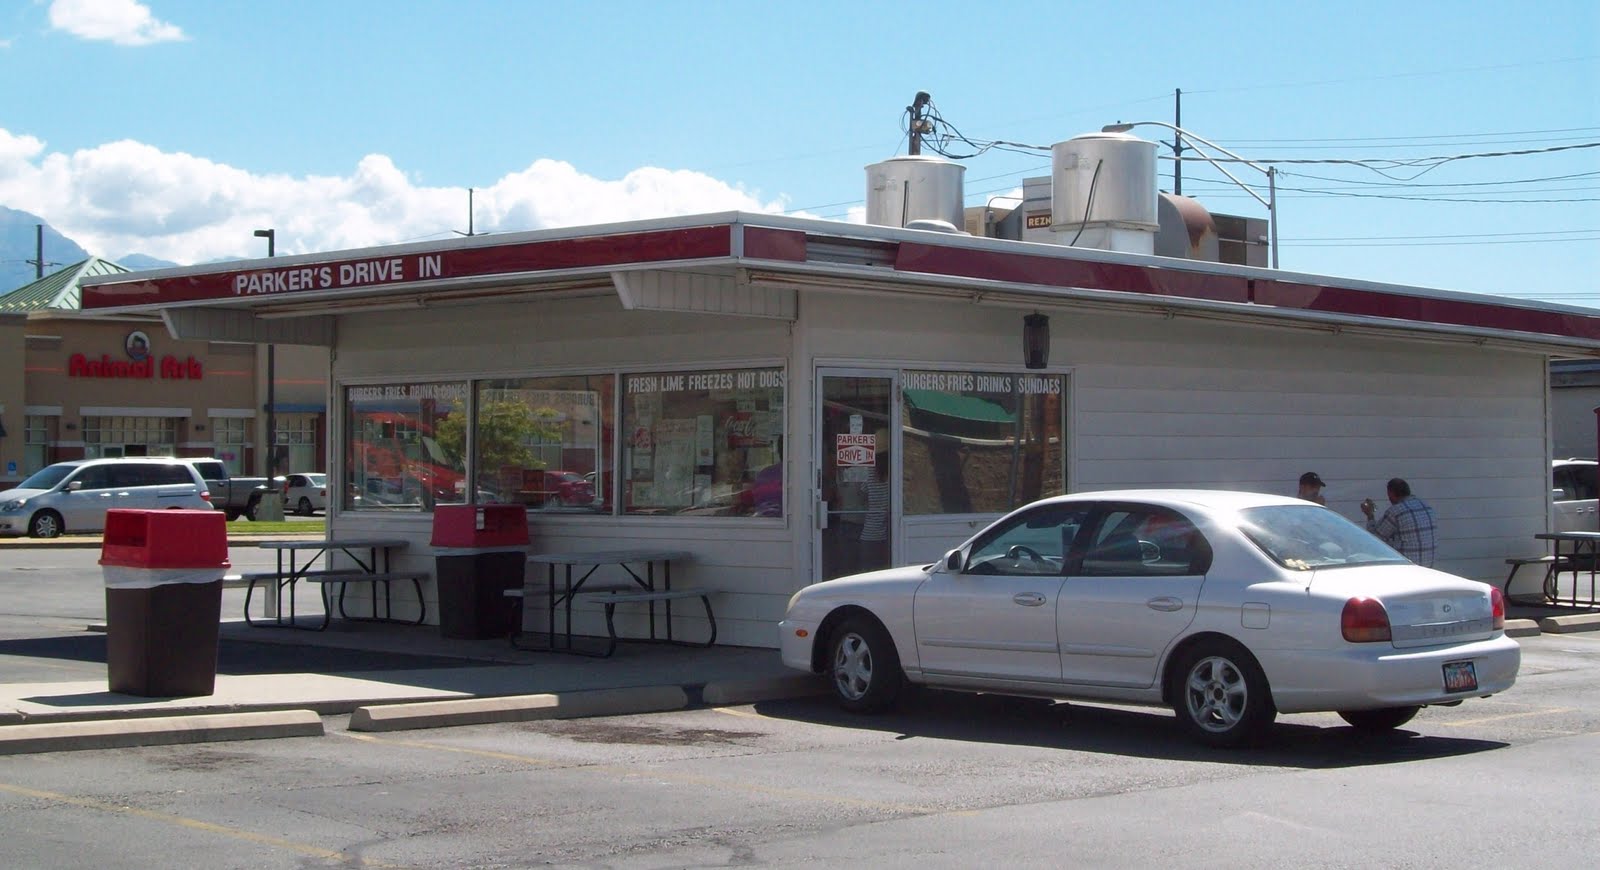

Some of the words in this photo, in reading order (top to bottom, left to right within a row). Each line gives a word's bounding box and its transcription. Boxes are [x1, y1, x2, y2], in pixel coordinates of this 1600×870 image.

[236, 266, 332, 294] PARKER'S
[339, 259, 403, 285] DRIVE
[418, 254, 441, 278] IN
[69, 353, 154, 378] Animal
[161, 355, 203, 379] Ark
[349, 386, 383, 401] BURGERS
[385, 385, 407, 400] FRIES
[409, 385, 439, 400] DRINKS
[628, 377, 657, 393] FRESH
[661, 375, 685, 392] LIME
[688, 374, 733, 391] FREEZES
[738, 372, 757, 389] HOT
[759, 371, 785, 388] DOGS
[902, 373, 945, 391] BURGERS
[947, 375, 974, 392] FRIES
[977, 375, 1011, 393] DRINKS
[1018, 377, 1061, 395] SUNDAES
[839, 450, 862, 461] DRIVE
[865, 450, 874, 460] IN
